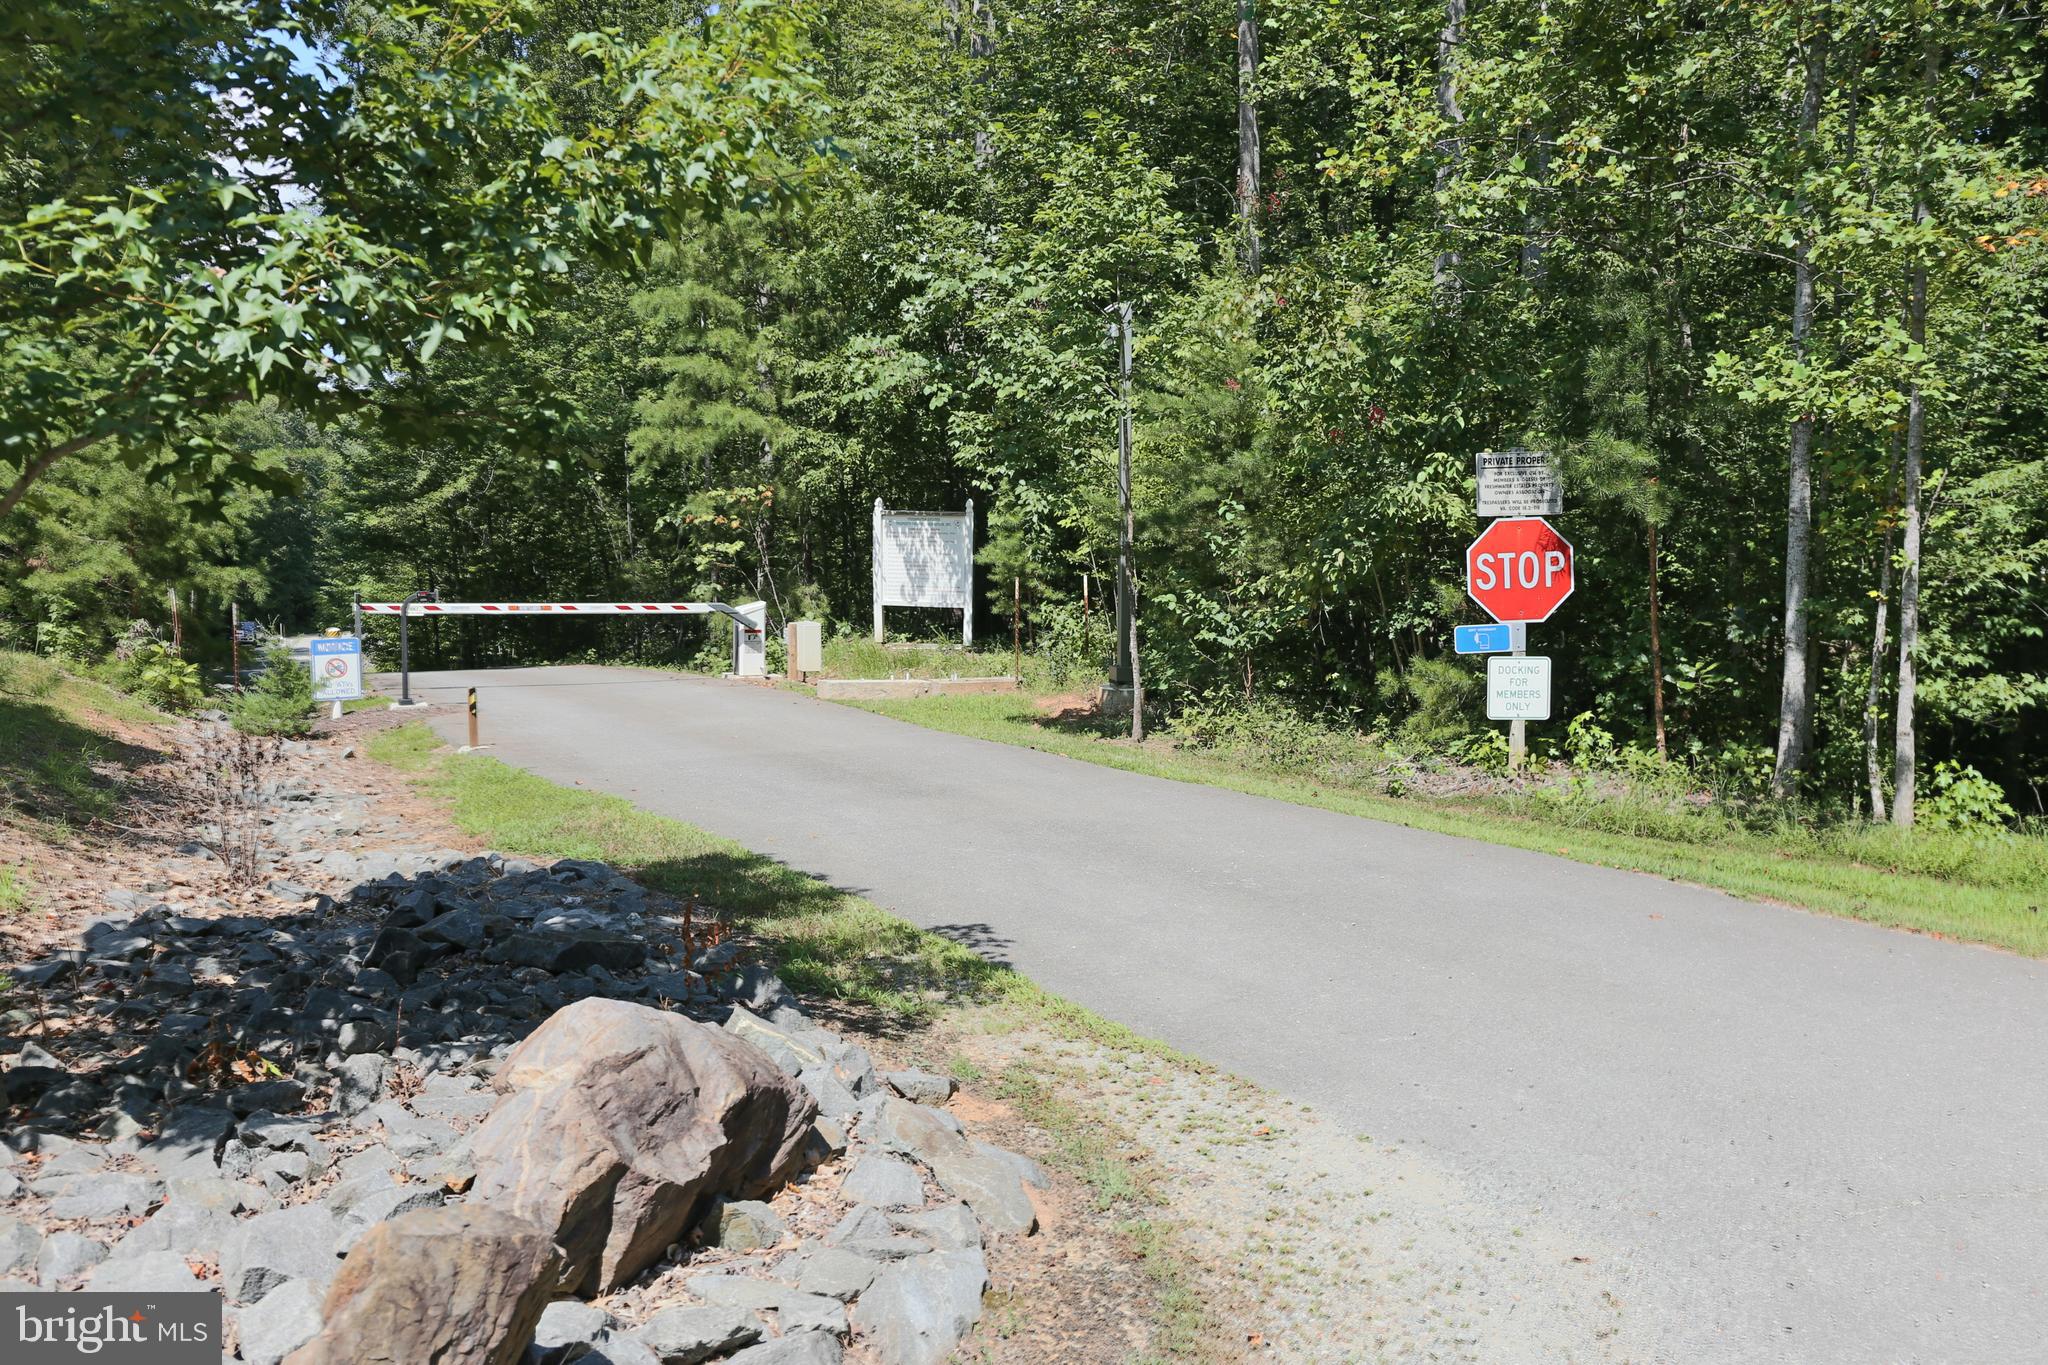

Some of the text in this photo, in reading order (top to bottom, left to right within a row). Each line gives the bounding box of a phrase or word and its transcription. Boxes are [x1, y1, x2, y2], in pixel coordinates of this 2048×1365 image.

[1483, 456, 1549, 465] PRIVATE PROPER
[1476, 551, 1566, 590] STOP
[1498, 665, 1540, 675] DOCKING
[1509, 678, 1528, 687] FOR
[1496, 690, 1541, 699] MEMBERS
[1505, 702, 1531, 711] ONLY
